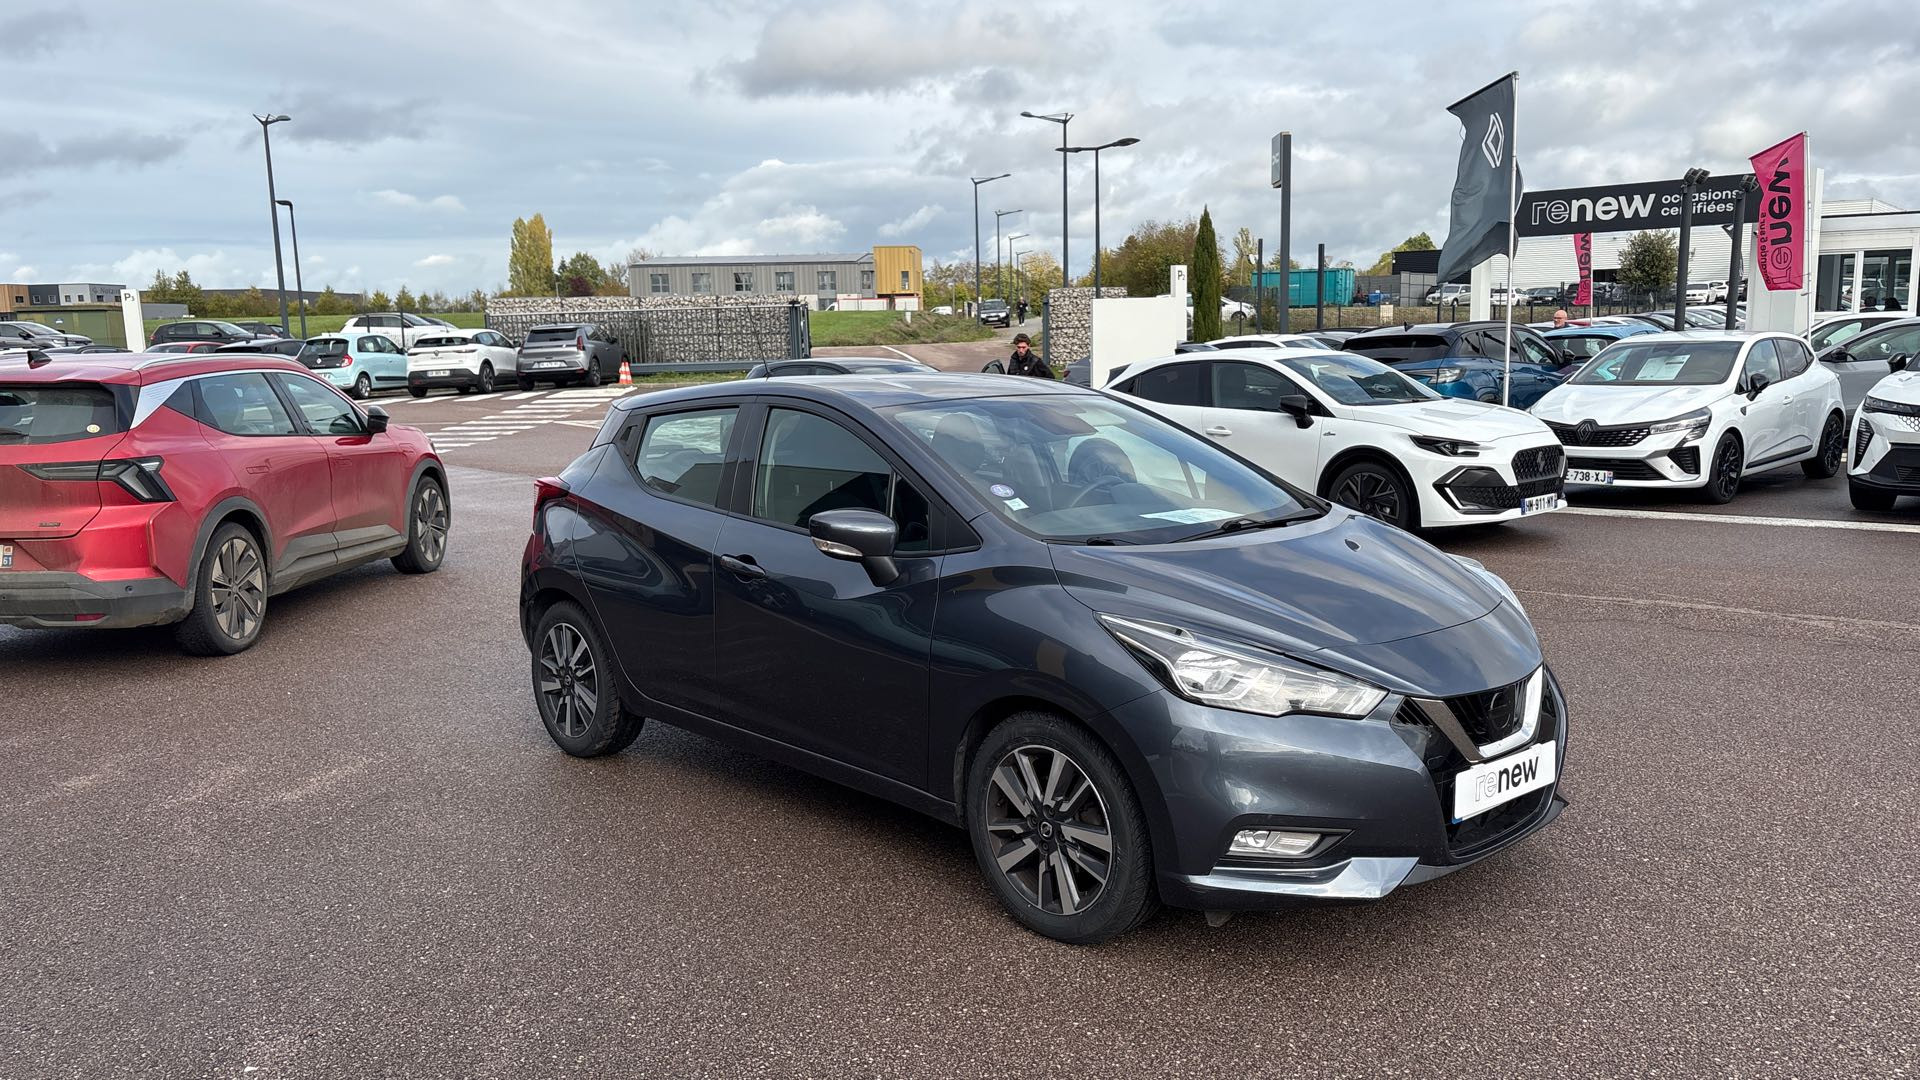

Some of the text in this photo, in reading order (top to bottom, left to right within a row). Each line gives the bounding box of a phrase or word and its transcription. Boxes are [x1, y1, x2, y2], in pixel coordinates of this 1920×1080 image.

[1661, 189, 1739, 204] ocasions
[1661, 201, 1734, 216] ceifiées
[1531, 193, 1656, 226] renew
[1475, 756, 1539, 802] renew
